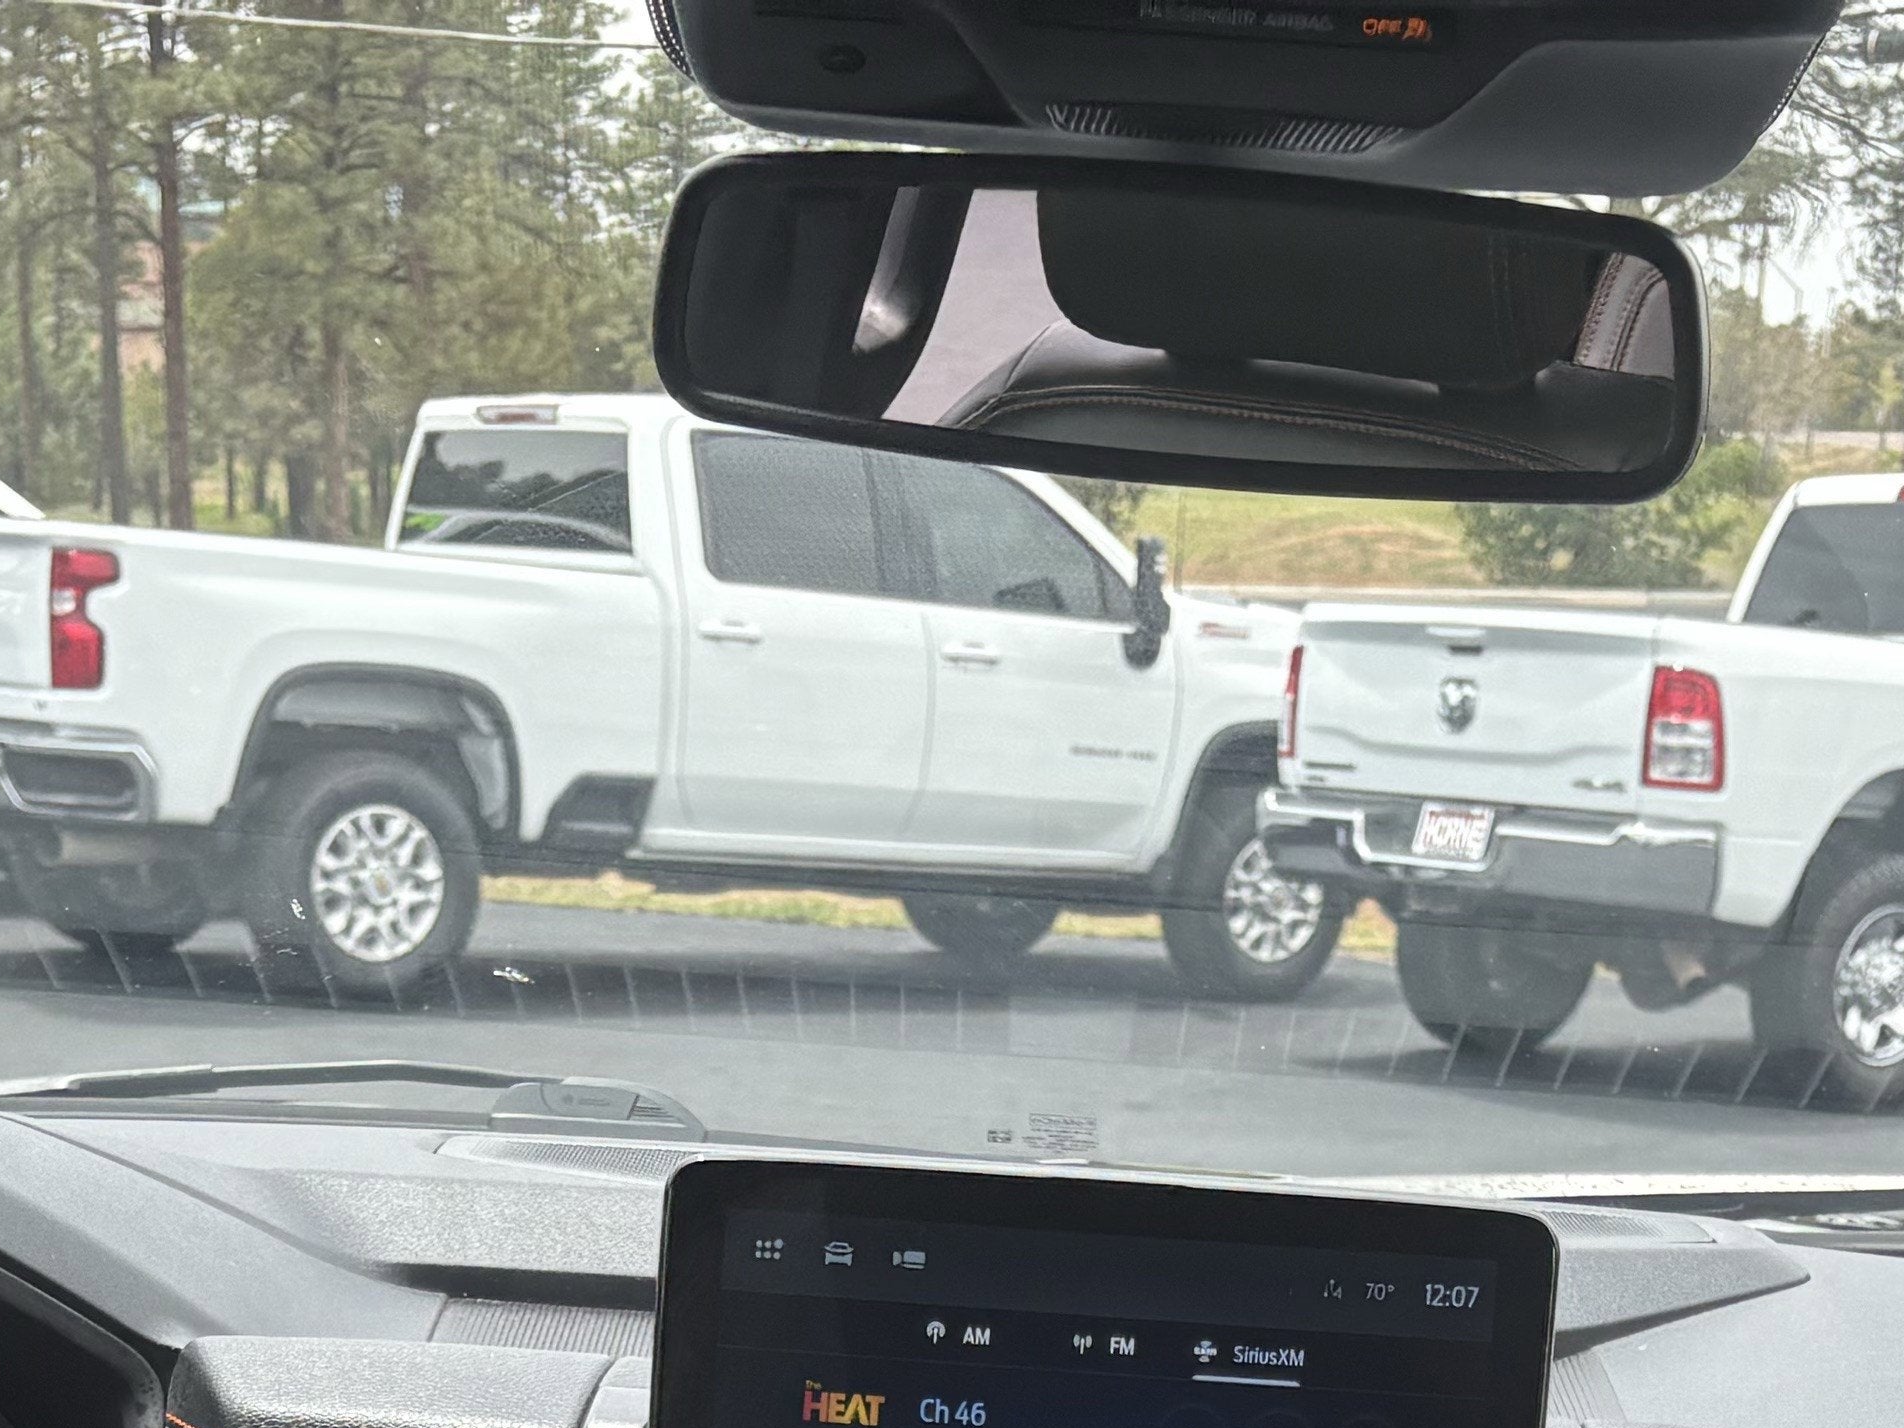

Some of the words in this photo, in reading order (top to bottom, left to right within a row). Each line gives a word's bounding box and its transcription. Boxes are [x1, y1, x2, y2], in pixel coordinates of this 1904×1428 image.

[1424, 1283, 1480, 1309] 12:07
[962, 1325, 991, 1346] AM
[1109, 1335, 1135, 1356] FM
[1232, 1345, 1305, 1367] SiriusXM
[802, 1391, 885, 1427] HEAT
[919, 1398, 949, 1425] Ch
[954, 1401, 987, 1427] 46
